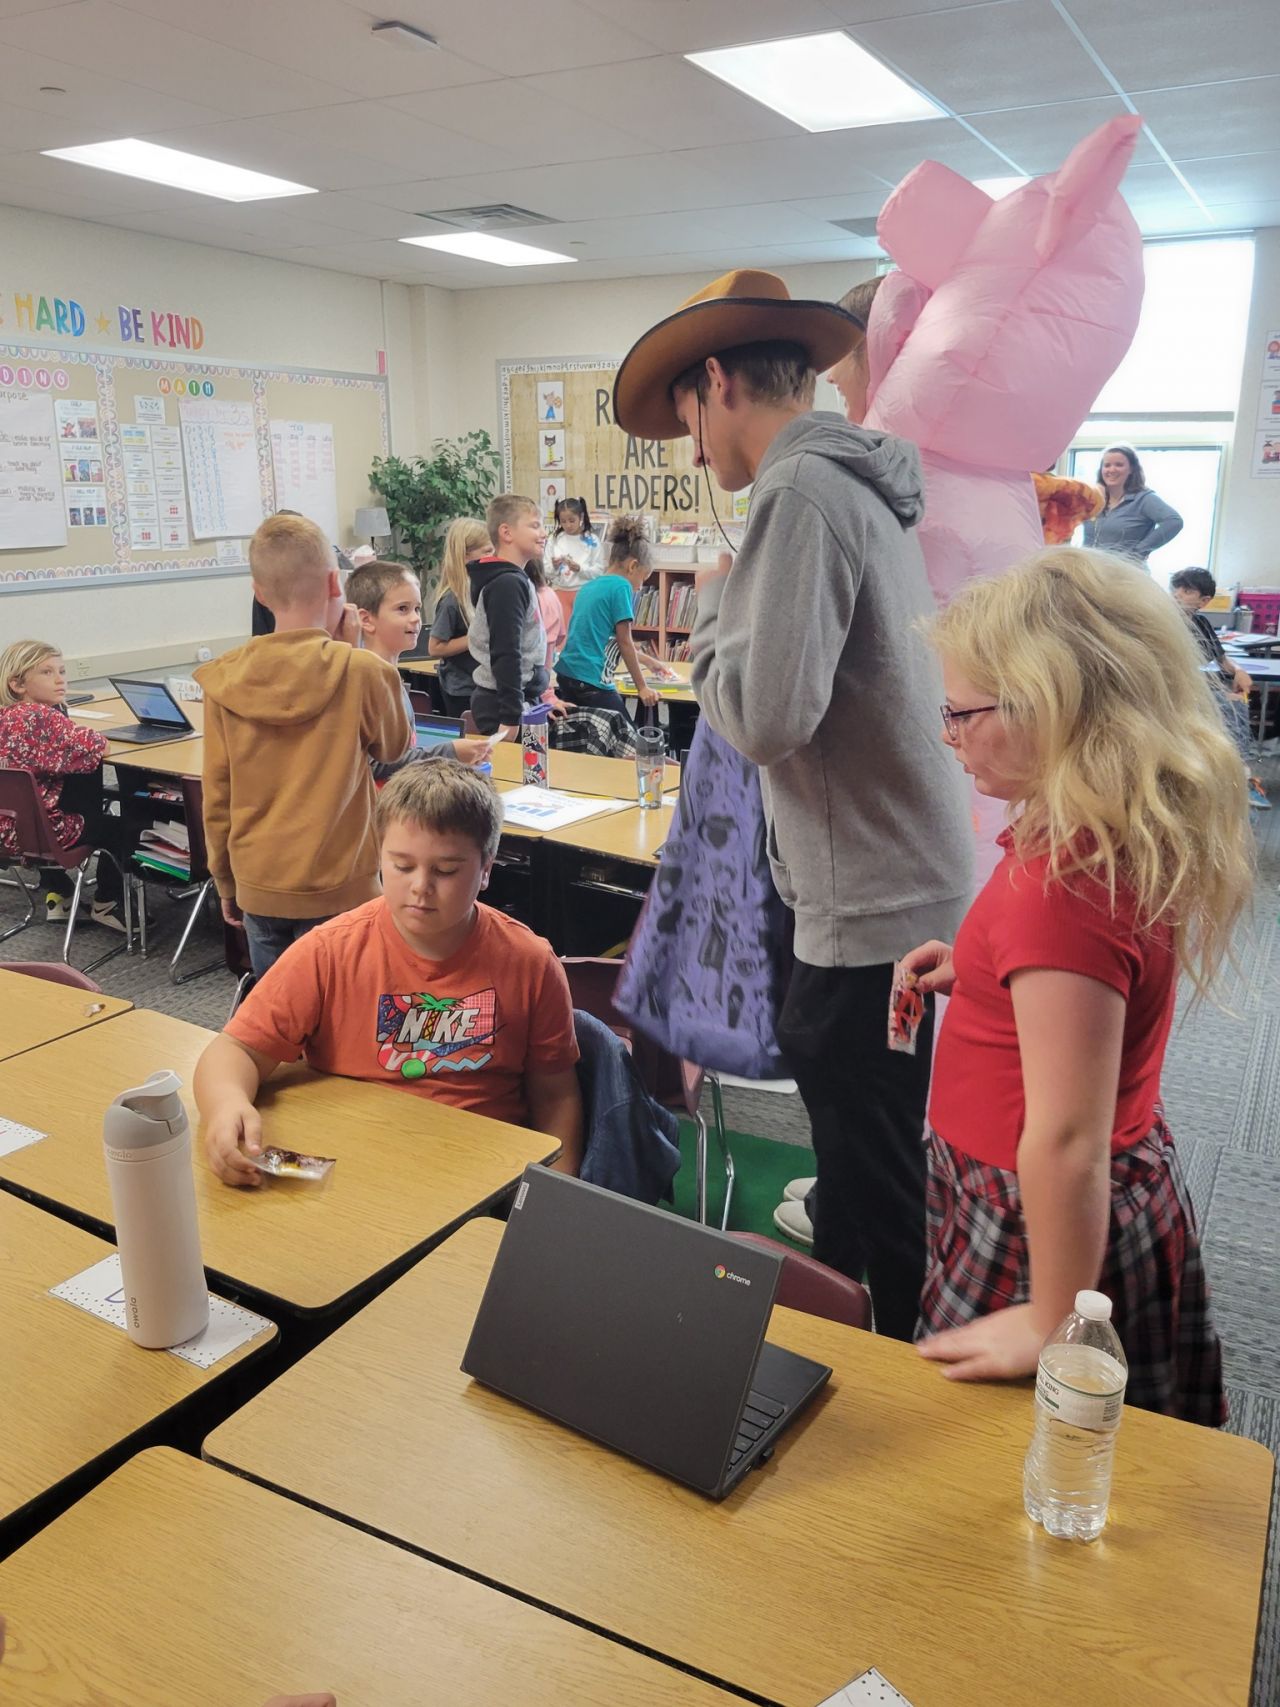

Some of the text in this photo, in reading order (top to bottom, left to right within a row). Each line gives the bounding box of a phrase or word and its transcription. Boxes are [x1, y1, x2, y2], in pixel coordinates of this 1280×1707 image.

[14, 292, 205, 350] HARD BE KIND
[160, 378, 213, 397] MATH
[624, 433, 669, 470] ARE
[594, 473, 700, 514] LEADERS!
[397, 1008, 480, 1043] NIKE
[726, 1271, 751, 1286] chrome
[130, 1296, 140, 1329] owala
